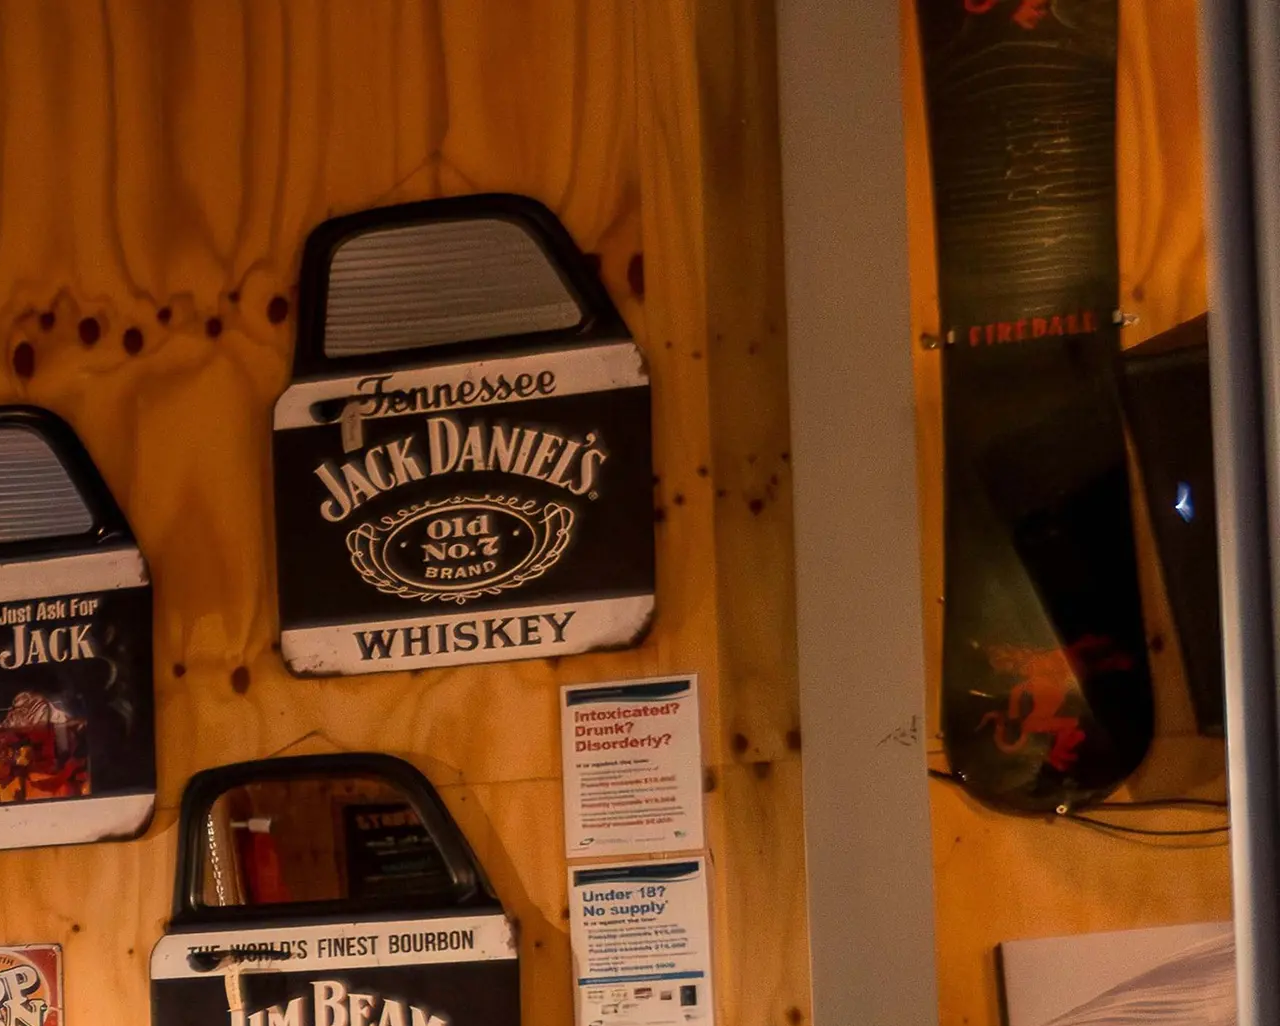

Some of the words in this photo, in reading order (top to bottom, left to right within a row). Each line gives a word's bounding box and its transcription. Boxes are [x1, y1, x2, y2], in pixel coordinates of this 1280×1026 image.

[970, 312, 1097, 346] FIREBALL
[356, 369, 557, 416] Tennessee
[313, 433, 428, 522] JACK
[427, 417, 608, 496] DANIEL'S
[427, 516, 489, 540] Old
[425, 560, 497, 579] BRAND
[36, 601, 66, 621] Ask
[70, 598, 99, 618] For
[353, 611, 577, 662] WHISKEY
[575, 703, 680, 723] Intoxicated?
[575, 722, 634, 737] Drunk?
[575, 734, 672, 752] Disorderly?
[582, 889, 632, 903] Under
[638, 886, 667, 900] 18?
[583, 905, 606, 917] No
[318, 936, 378, 957] FINEST
[389, 930, 474, 954] BOURBON
